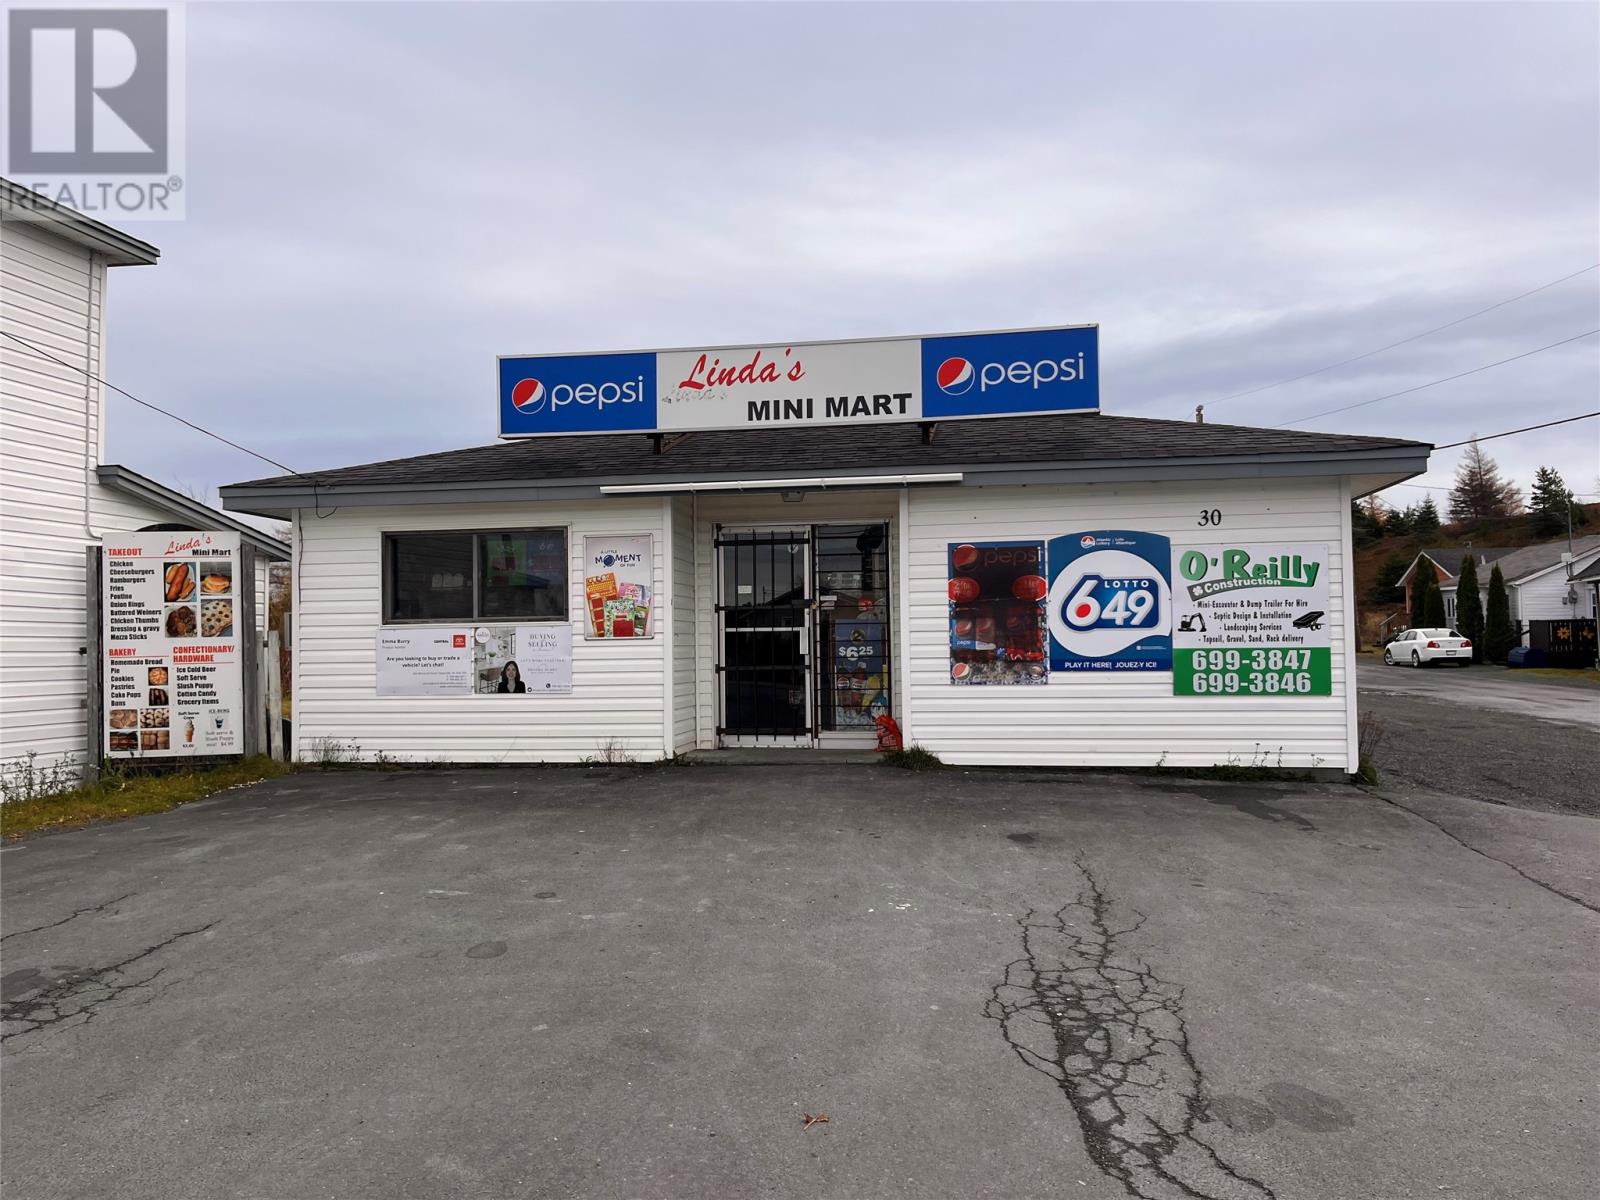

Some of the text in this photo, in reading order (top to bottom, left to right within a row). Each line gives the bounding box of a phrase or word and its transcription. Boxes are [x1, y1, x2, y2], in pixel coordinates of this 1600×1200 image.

[679, 348, 805, 390] Linda's
[981, 352, 1086, 391] pepsi
[551, 375, 644, 412] pepsi
[748, 393, 912, 421] MINI MART
[1198, 509, 1222, 526] 30
[108, 548, 142, 556] TAKEOUT
[165, 533, 211, 555] Linda's
[1180, 549, 1320, 587] O'Reilly
[1104, 580, 1150, 588] LOTTO
[1204, 578, 1281, 594] Construction
[1247, 600, 1262, 609] Dump
[1214, 612, 1230, 621] Septic
[1233, 612, 1251, 621] Design
[1260, 611, 1292, 619] Installation
[1224, 623, 1282, 632] Landscaping Services
[1203, 635, 1224, 644] Topsoil,
[1227, 635, 1246, 643] Gravel,
[1249, 635, 1264, 643] Sand,
[1282, 634, 1304, 644] delivery
[109, 648, 136, 656] BAKERY
[173, 645, 234, 653] CONFECTIONARY/
[1192, 650, 1311, 670] 699-3847
[1192, 672, 1311, 693] 699-3846
